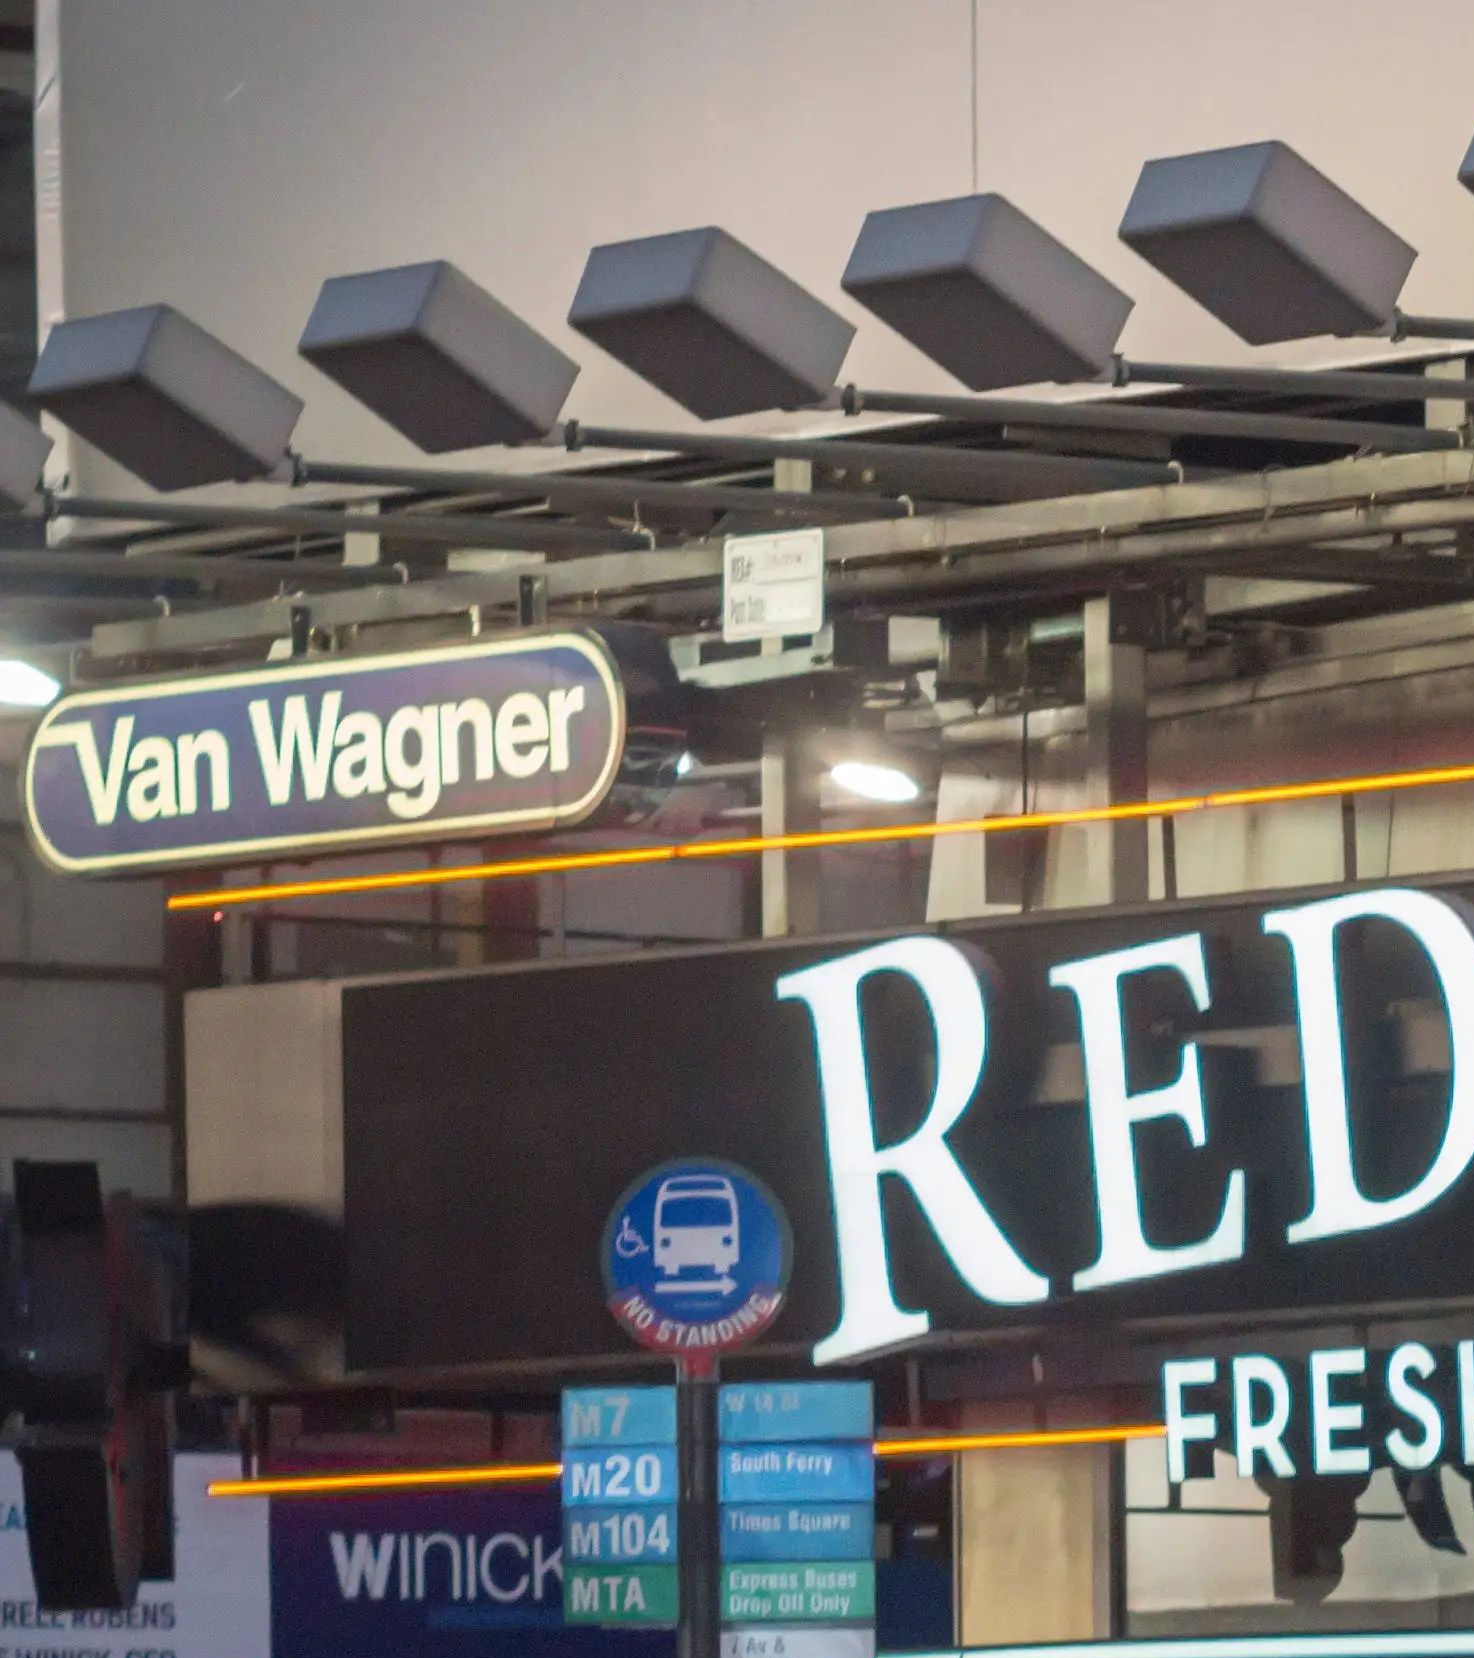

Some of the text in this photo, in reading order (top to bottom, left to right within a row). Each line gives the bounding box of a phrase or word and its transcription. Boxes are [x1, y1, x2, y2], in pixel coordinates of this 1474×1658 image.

[48, 683, 585, 827] Van Wagner
[623, 1296, 655, 1329] NO
[570, 1395, 633, 1438] M7
[571, 1454, 662, 1498] M20
[730, 1451, 781, 1474] South
[570, 1513, 670, 1557] M104
[729, 1511, 782, 1532] Times
[571, 1575, 646, 1613] MTA
[729, 1570, 799, 1596] Express
[729, 1594, 772, 1617] Drop
